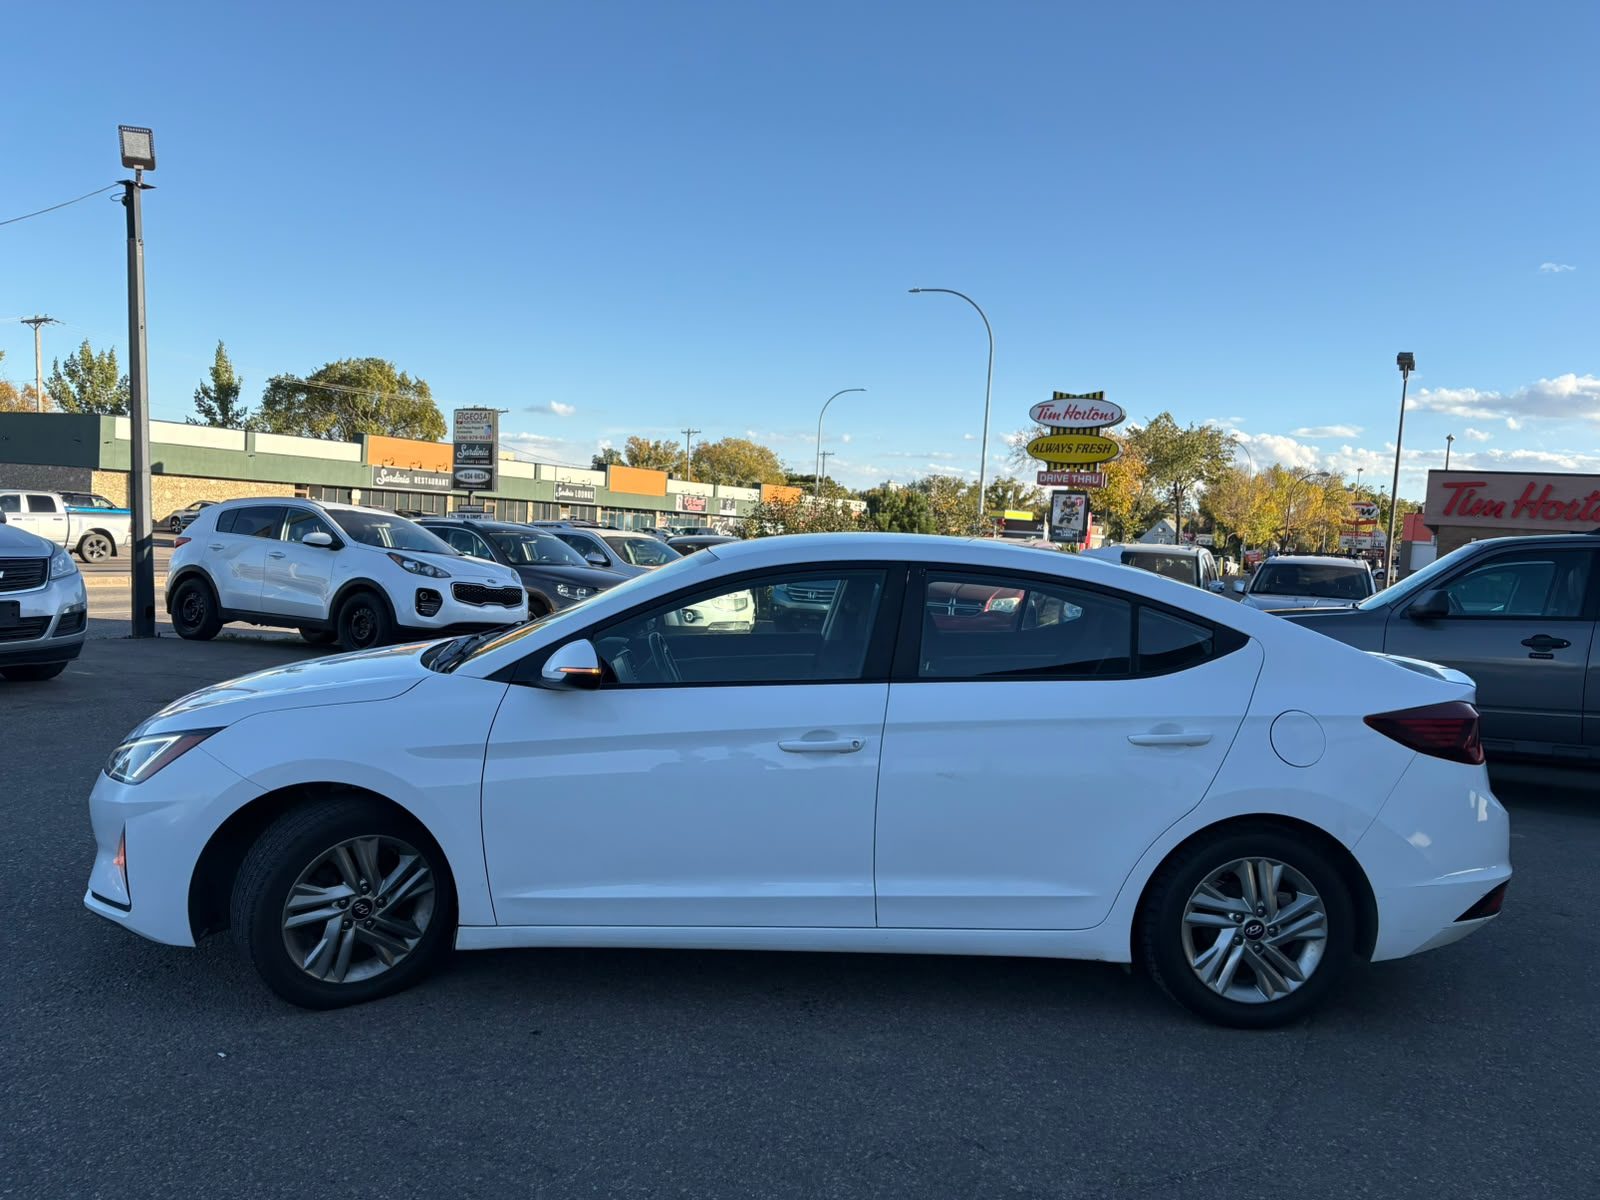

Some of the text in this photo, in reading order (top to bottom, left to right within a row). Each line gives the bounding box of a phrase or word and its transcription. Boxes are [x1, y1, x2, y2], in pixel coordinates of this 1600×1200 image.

[463, 412, 491, 421] GEOSAT
[1037, 404, 1115, 421] Tim Hortons
[457, 444, 489, 459] Sardinia
[1032, 443, 1113, 455] ALWAYS FRESH
[376, 469, 449, 486] Sardinia RESTAURANT
[1039, 473, 1100, 484] DRIVE THRU
[1443, 481, 1506, 518] Tim
